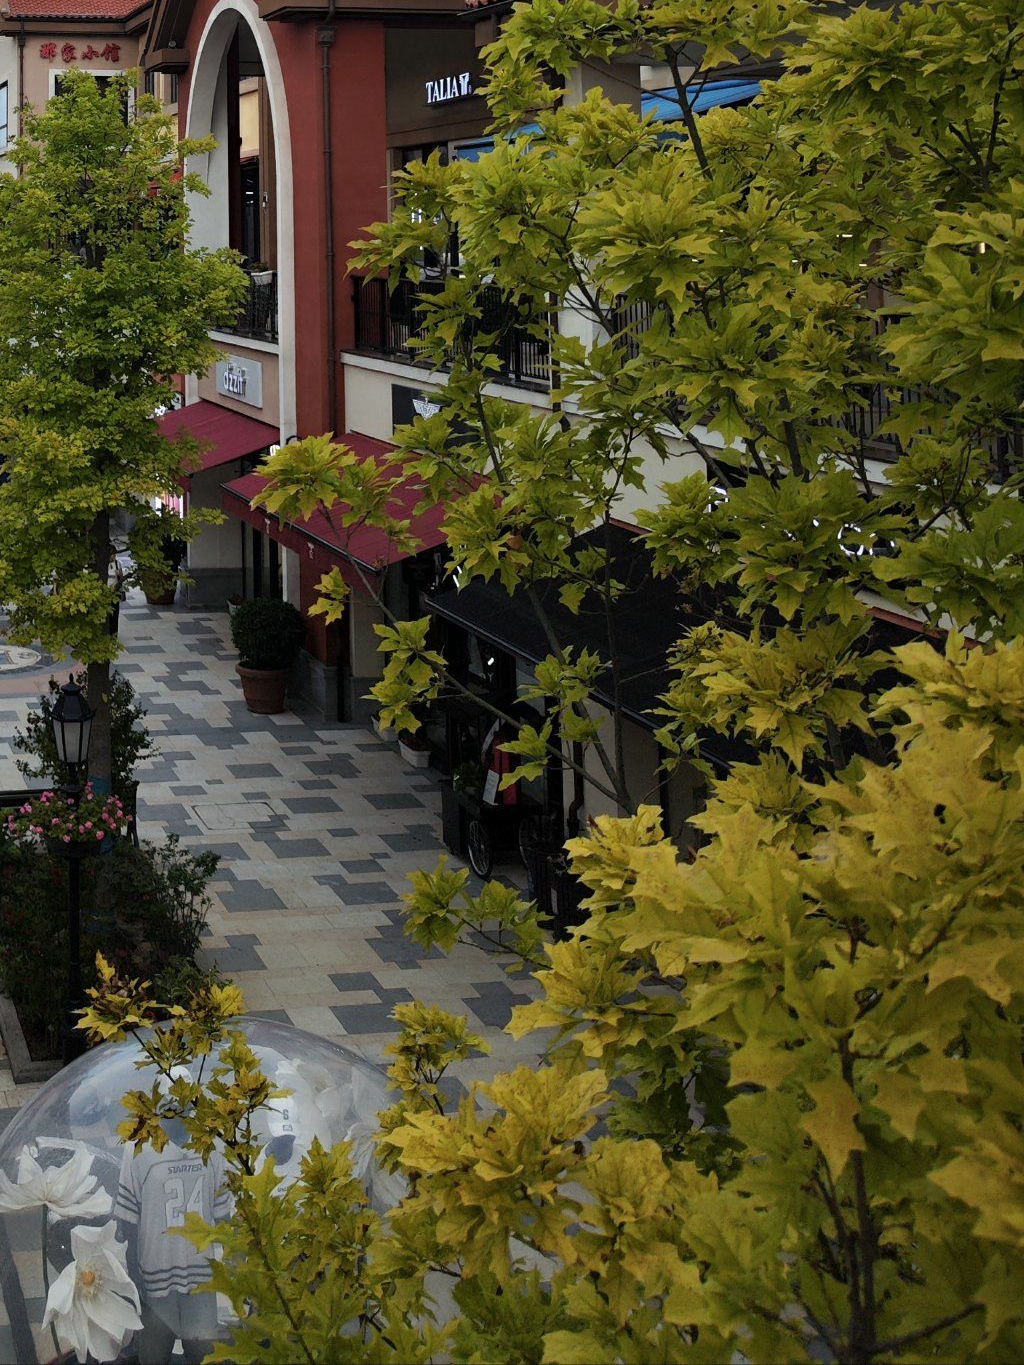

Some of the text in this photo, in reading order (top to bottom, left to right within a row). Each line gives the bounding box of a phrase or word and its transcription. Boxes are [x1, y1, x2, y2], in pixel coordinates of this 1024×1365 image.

[425, 75, 459, 103] TALIA
[167, 1163, 203, 1175] STARTER
[163, 1175, 205, 1228] 24
